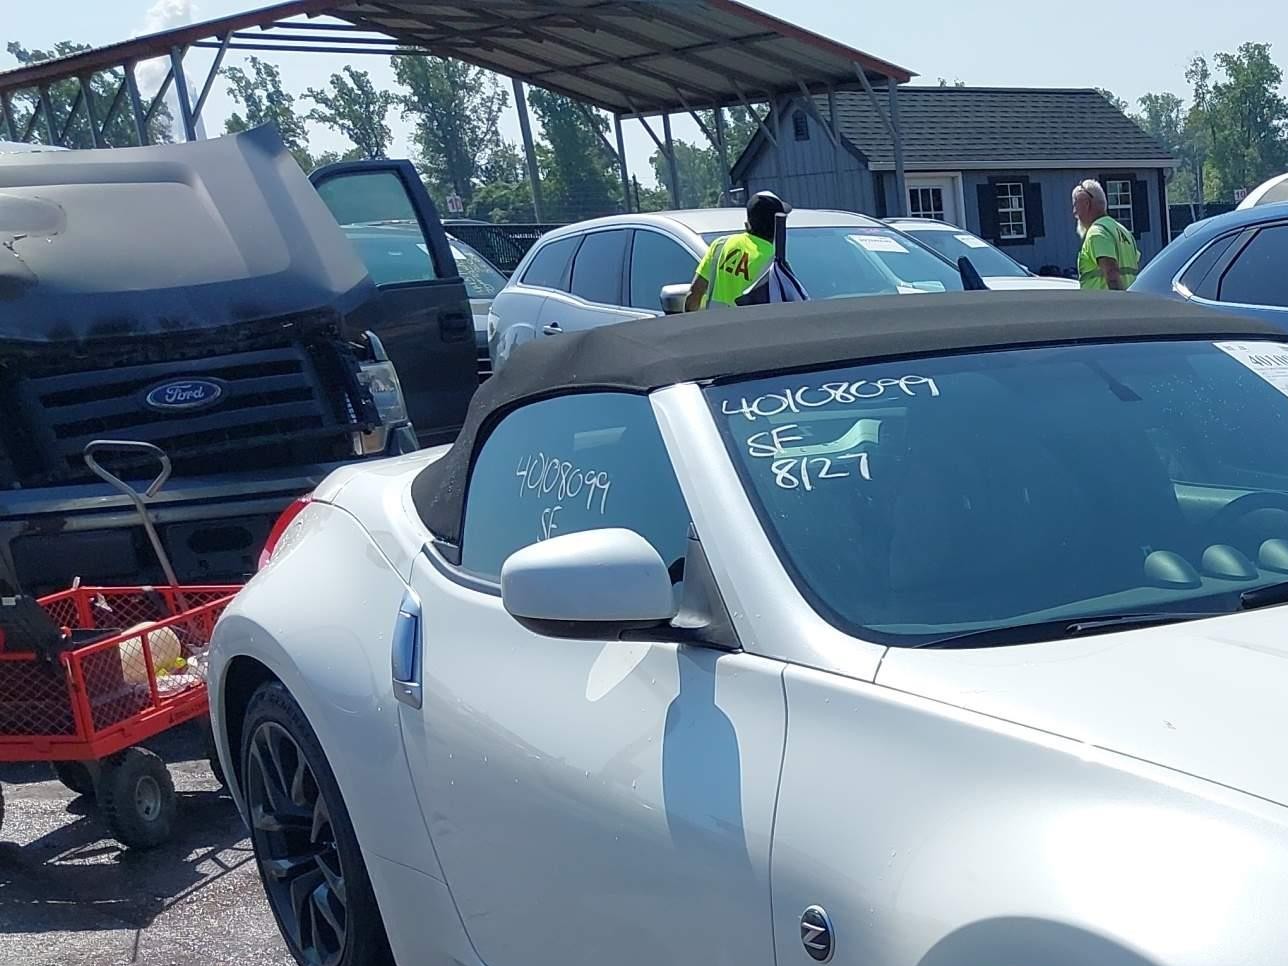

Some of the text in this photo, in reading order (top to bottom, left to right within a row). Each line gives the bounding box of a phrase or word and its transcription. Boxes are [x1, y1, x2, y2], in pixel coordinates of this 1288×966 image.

[165, 384, 205, 403] Ford
[722, 375, 940, 421] 40108099
[516, 452, 612, 515] 40108099
